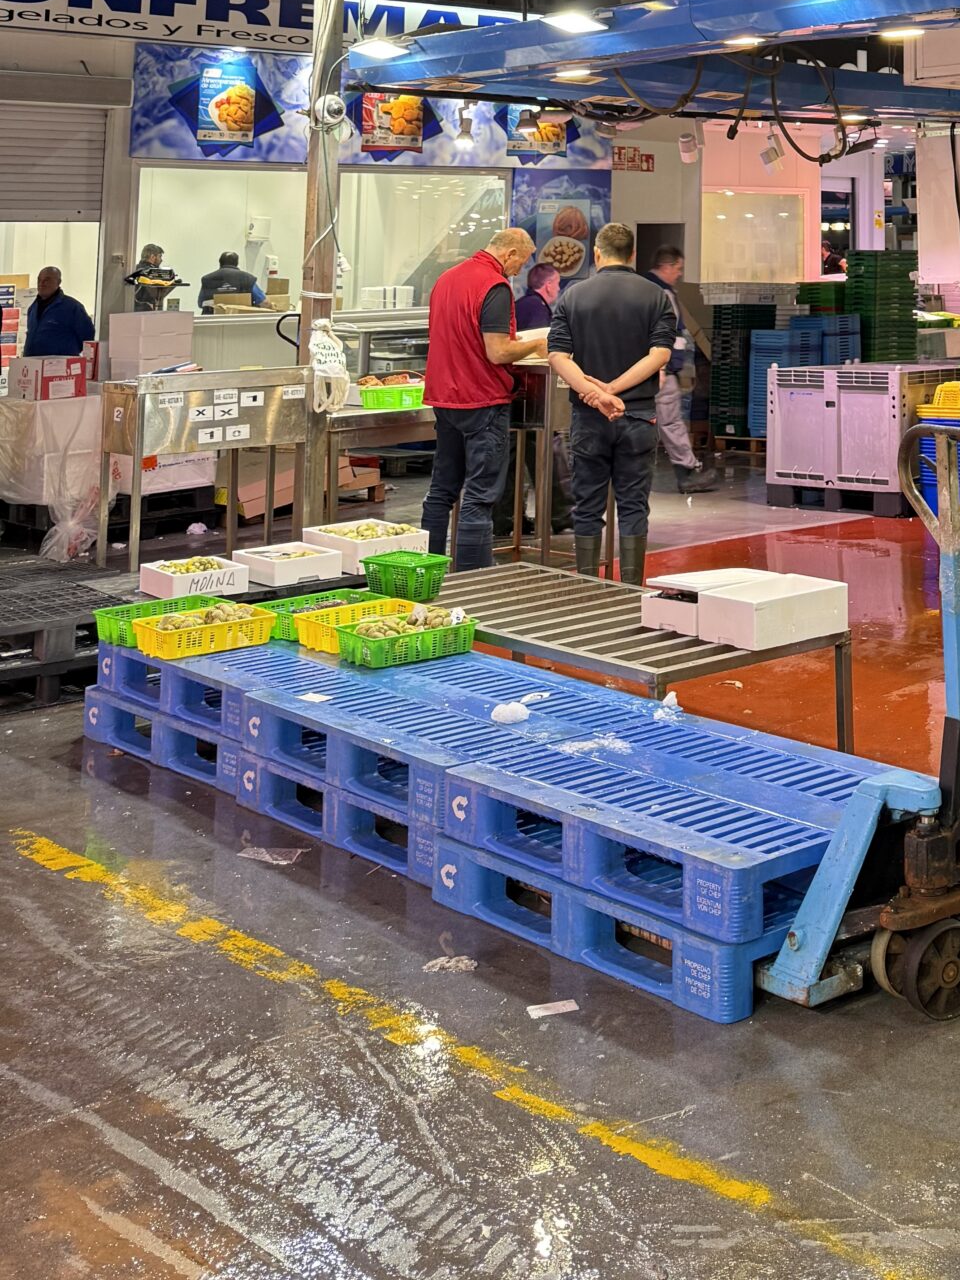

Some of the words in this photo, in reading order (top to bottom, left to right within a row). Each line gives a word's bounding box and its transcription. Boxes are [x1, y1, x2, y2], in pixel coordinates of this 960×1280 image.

[162, 24, 183, 37] y
[197, 24, 311, 45] Fresco
[115, 409, 122, 419] 2
